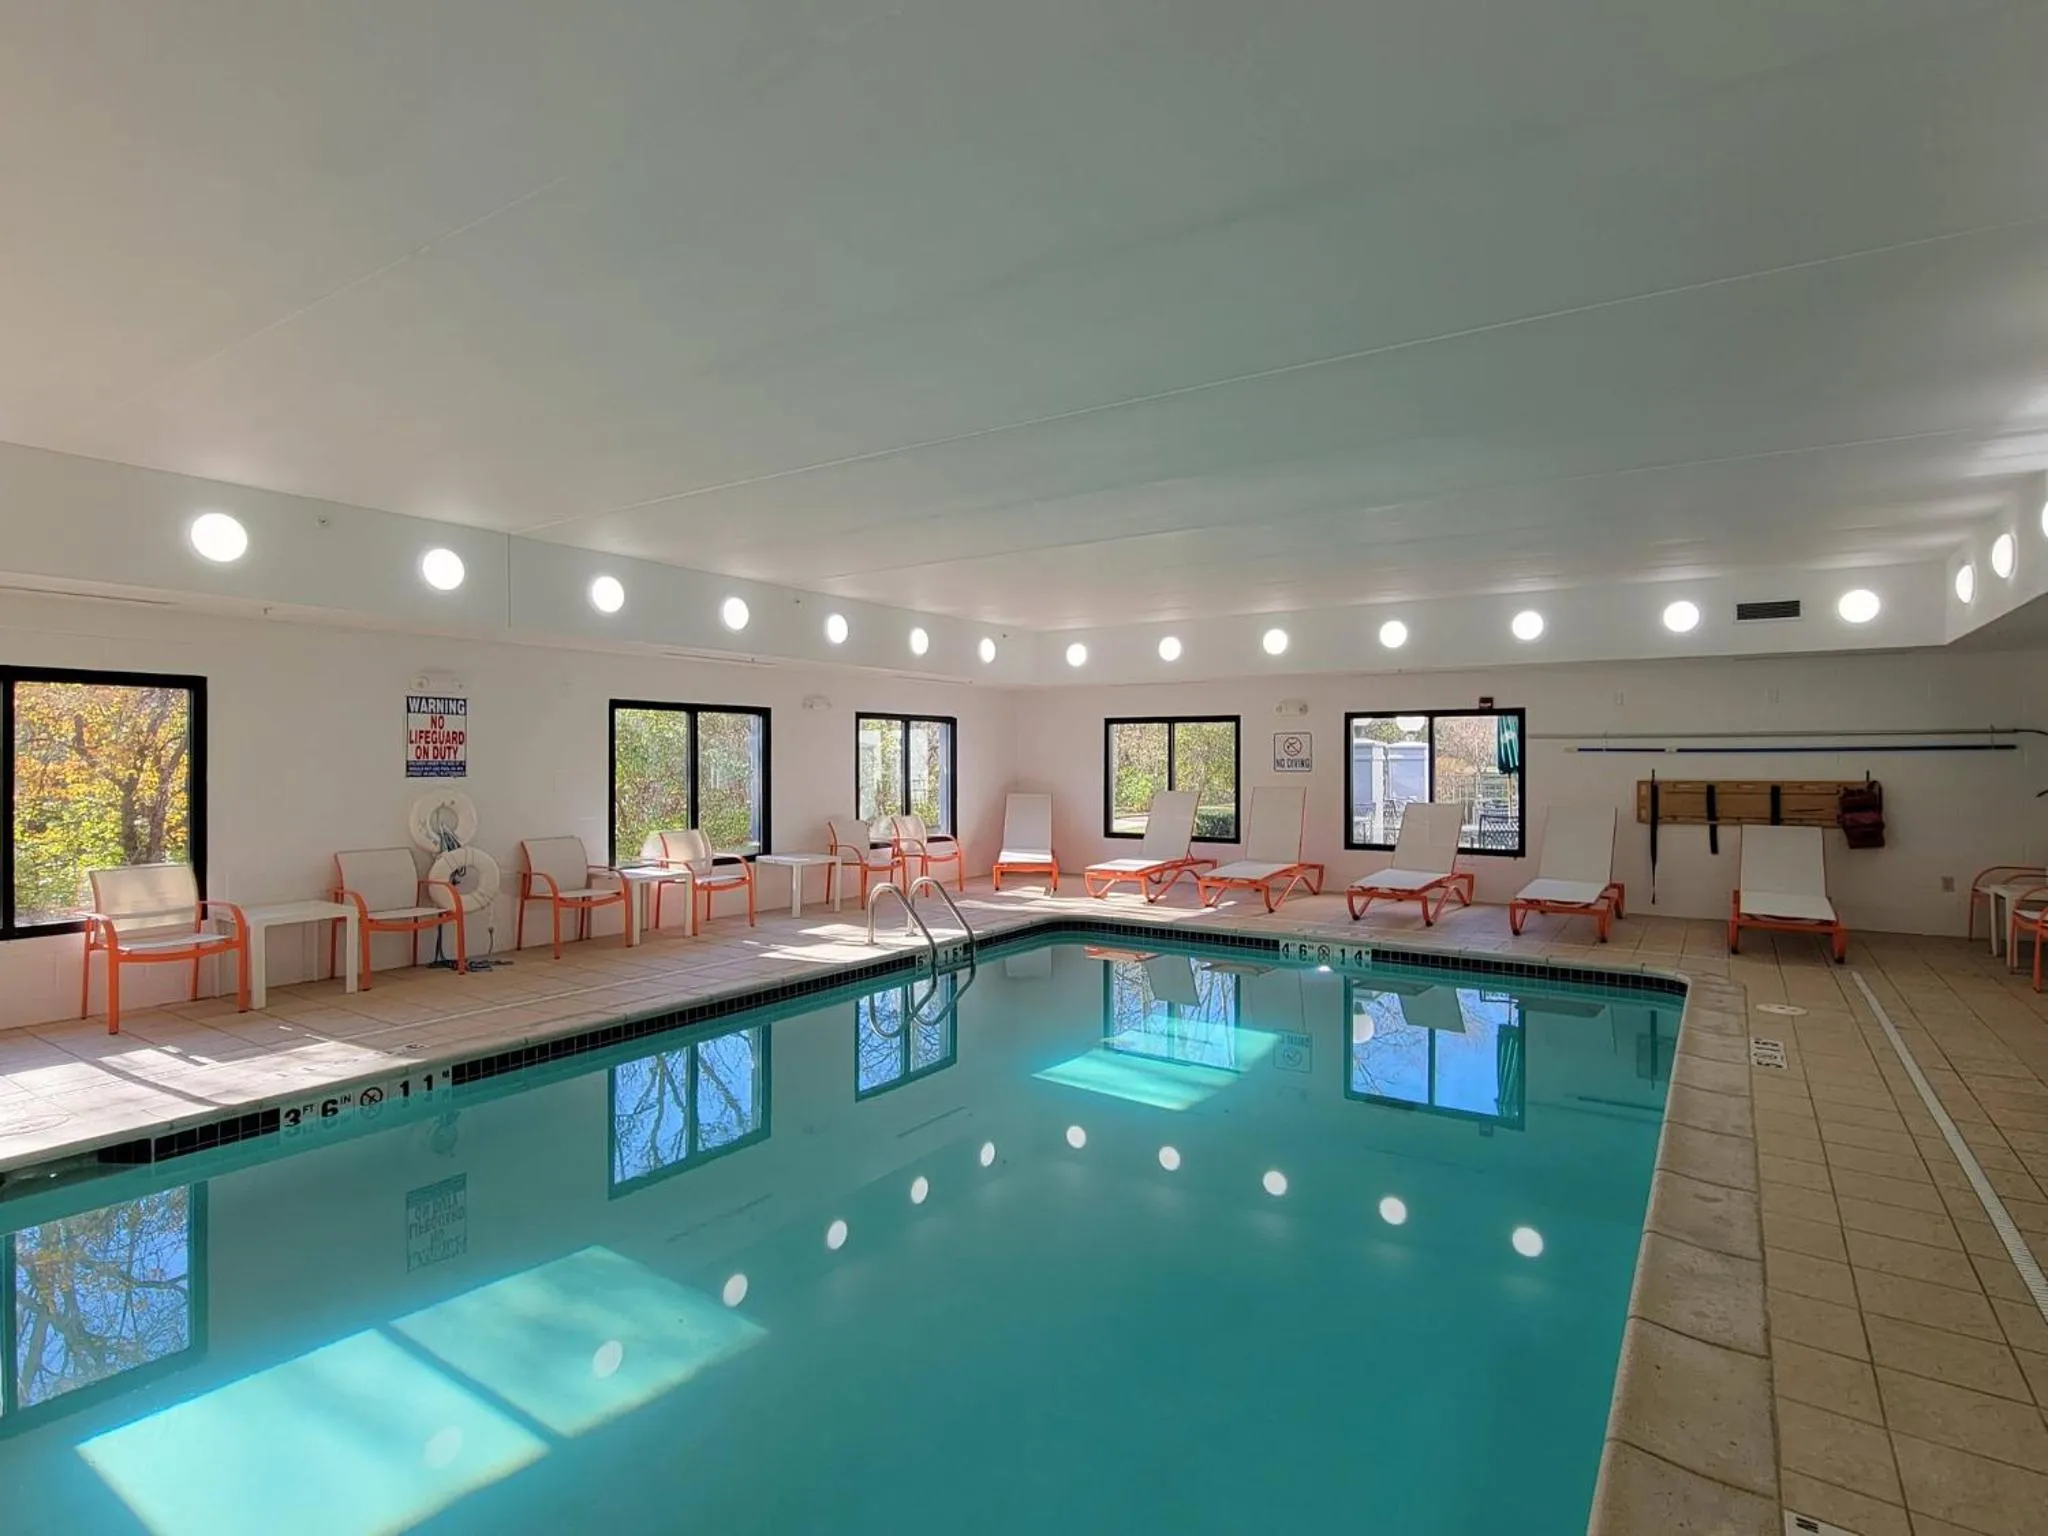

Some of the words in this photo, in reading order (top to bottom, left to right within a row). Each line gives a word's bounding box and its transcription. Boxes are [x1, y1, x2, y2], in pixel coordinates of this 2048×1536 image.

[408, 697, 466, 714] WARNING
[430, 715, 445, 729] NO
[409, 730, 465, 744] LIFEGUARD
[415, 745, 429, 759] ON
[432, 746, 458, 759] DUTY
[1276, 758, 1285, 768] NO
[1287, 758, 1310, 768] DIVING
